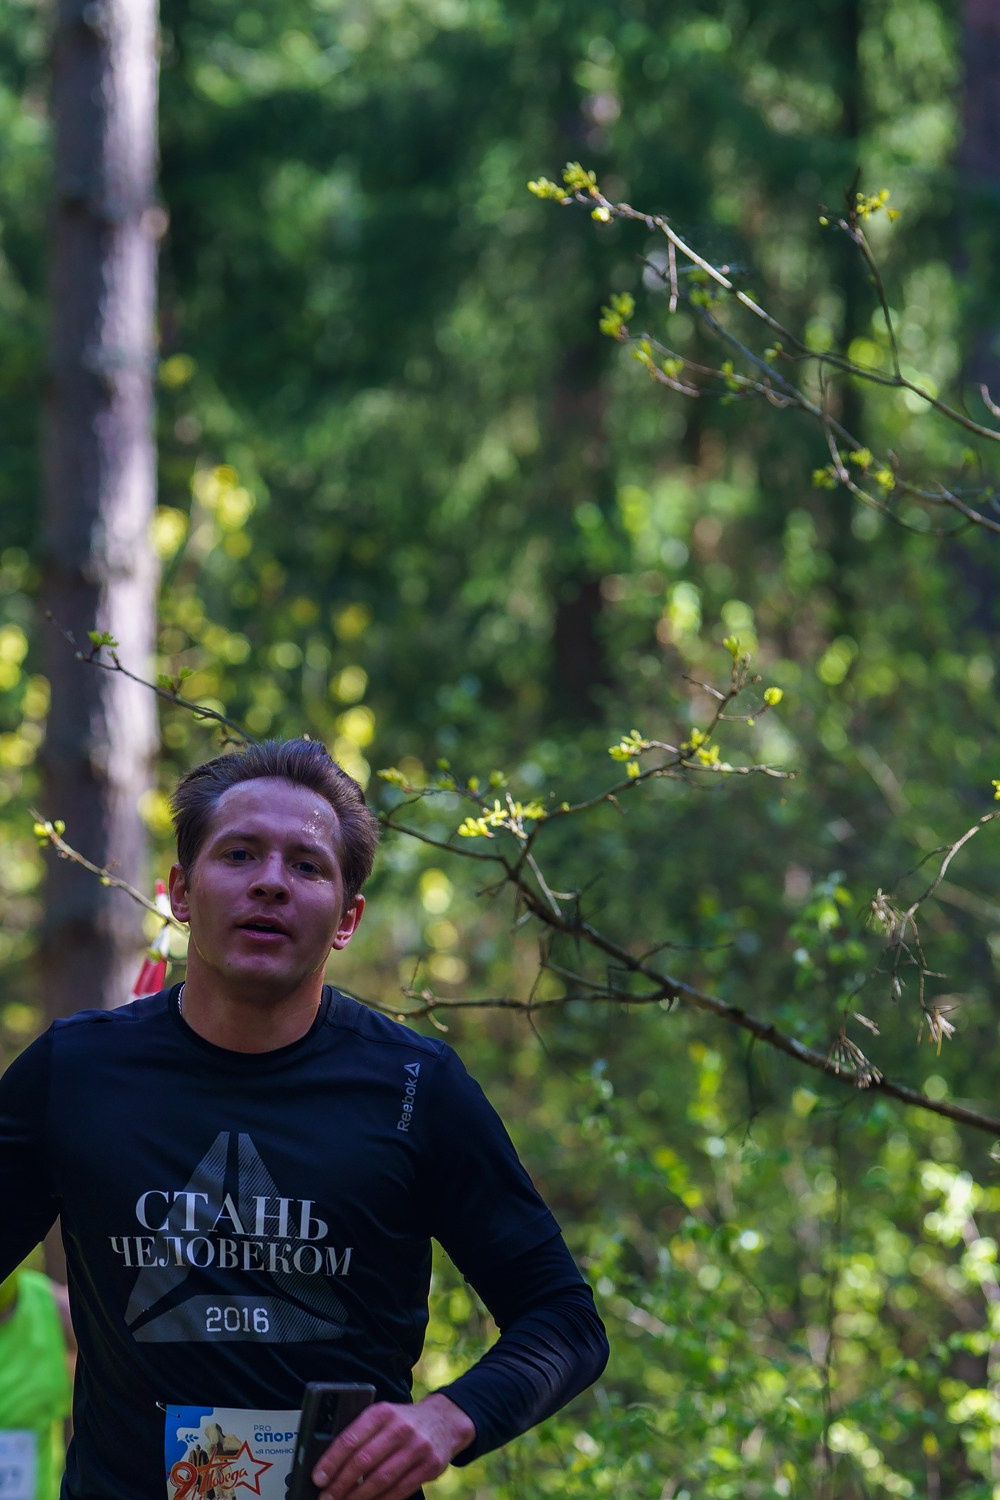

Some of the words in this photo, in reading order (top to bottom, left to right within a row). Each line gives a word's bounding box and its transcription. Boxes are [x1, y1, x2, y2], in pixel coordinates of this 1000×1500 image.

[397, 1077, 418, 1131] Reebok
[135, 1190, 329, 1240] СТАНЬ
[108, 1236, 354, 1276] ЧЕЛОВЕКОМ
[206, 1307, 270, 1333] 2016
[253, 1424, 272, 1432] PRO
